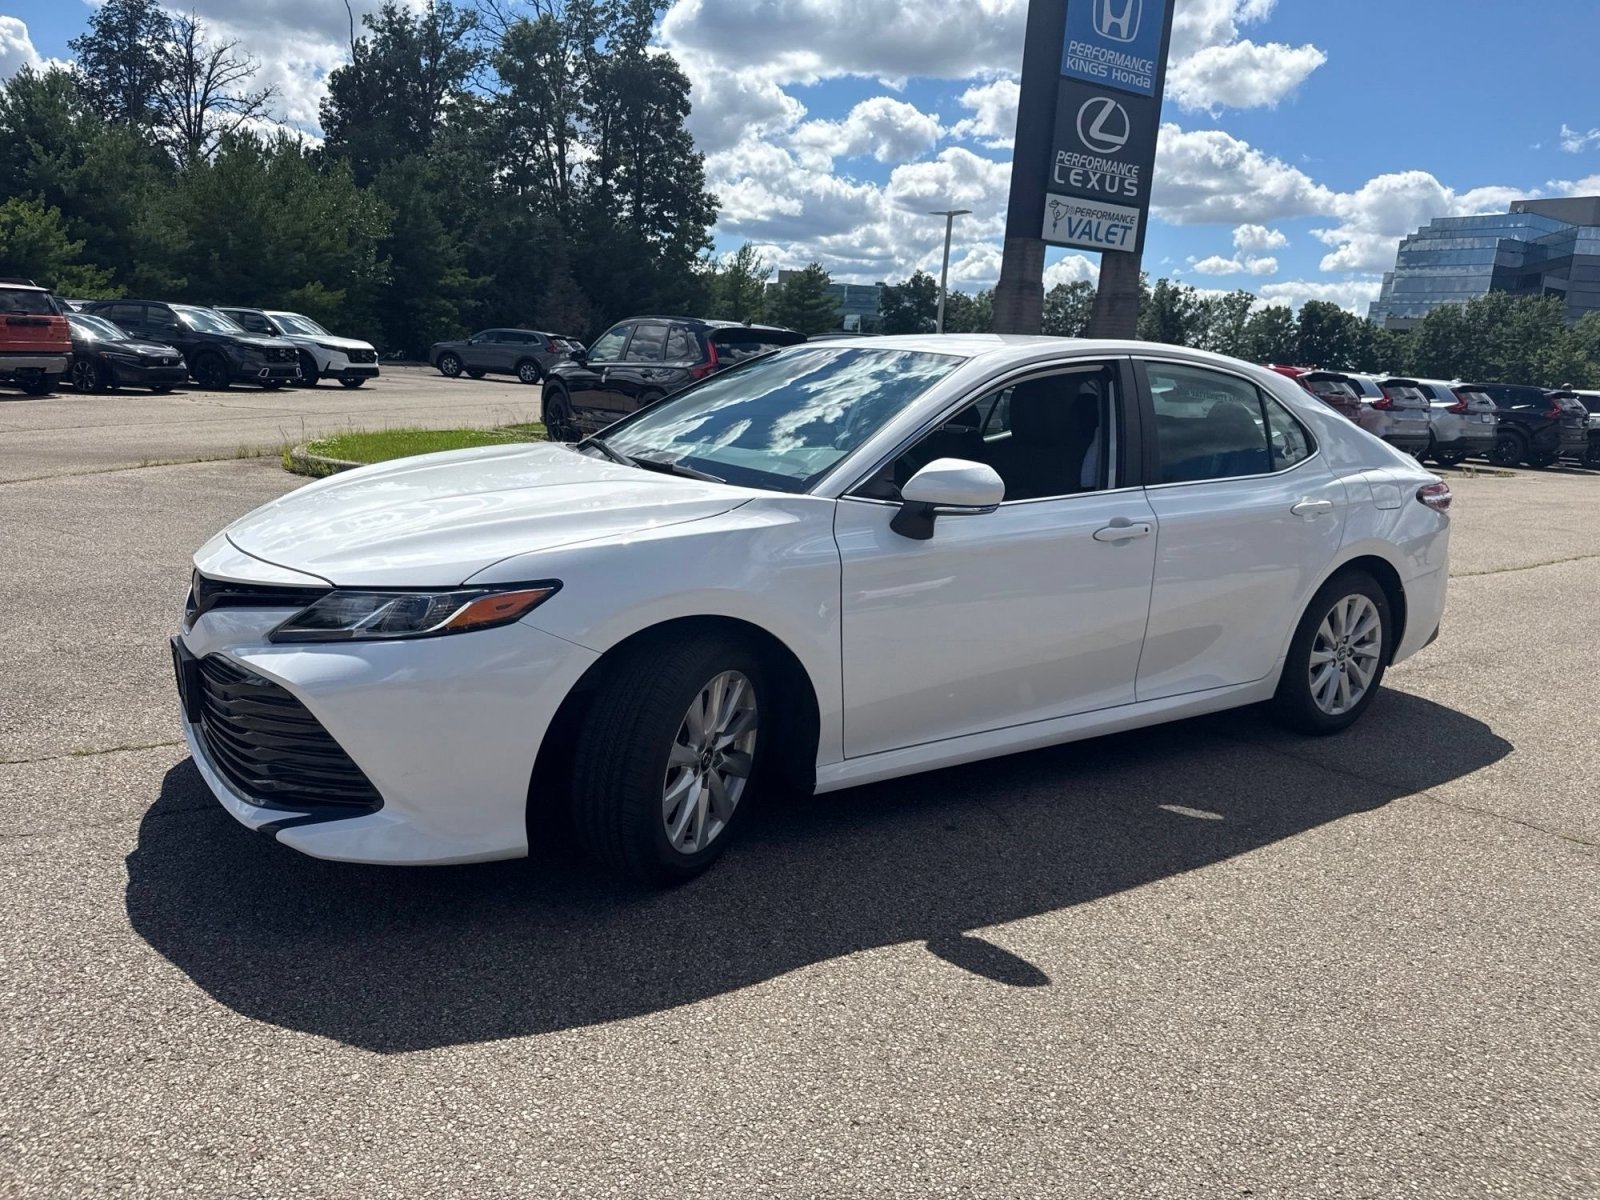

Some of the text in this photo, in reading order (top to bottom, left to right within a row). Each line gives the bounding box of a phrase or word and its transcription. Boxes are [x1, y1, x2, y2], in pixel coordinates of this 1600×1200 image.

[1066, 56, 1151, 88] KINGS Honda
[1068, 40, 1154, 74] PERFORMANCE
[1056, 150, 1140, 177] PERFORMANCE
[1054, 165, 1138, 196] LEXUS
[1074, 206, 1136, 225] PERFORMANCE
[1067, 216, 1133, 246] VALET
